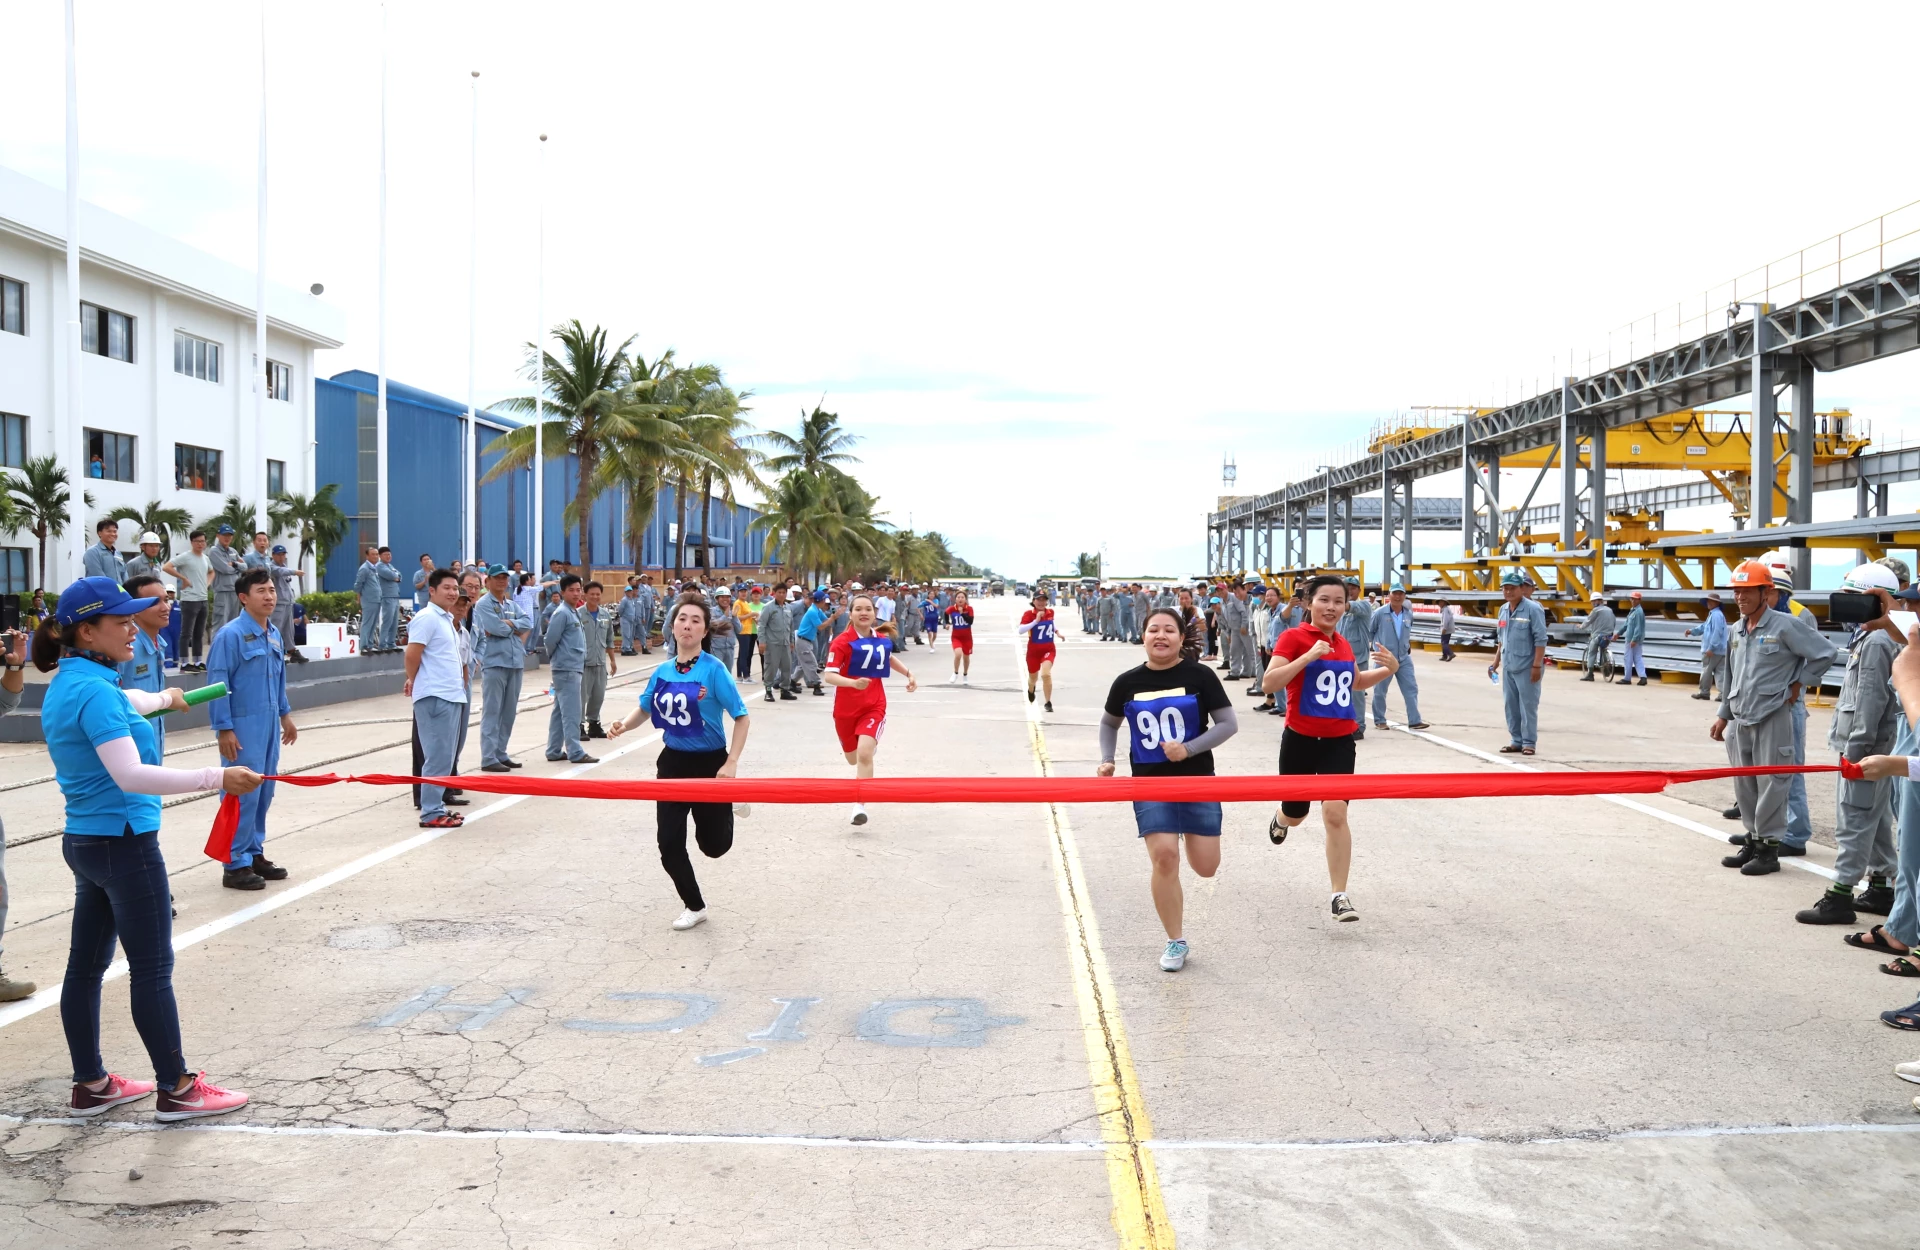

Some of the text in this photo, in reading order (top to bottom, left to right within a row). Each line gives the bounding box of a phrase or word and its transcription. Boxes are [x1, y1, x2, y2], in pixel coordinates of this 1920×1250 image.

[338, 626, 343, 642] 1
[1037, 624, 1054, 640] 74
[324, 647, 331, 659] 3
[349, 639, 355, 654] 2
[860, 644, 886, 670] 71
[1315, 669, 1354, 708] 98
[866, 718, 876, 729] 2
[1135, 706, 1186, 751] 90
